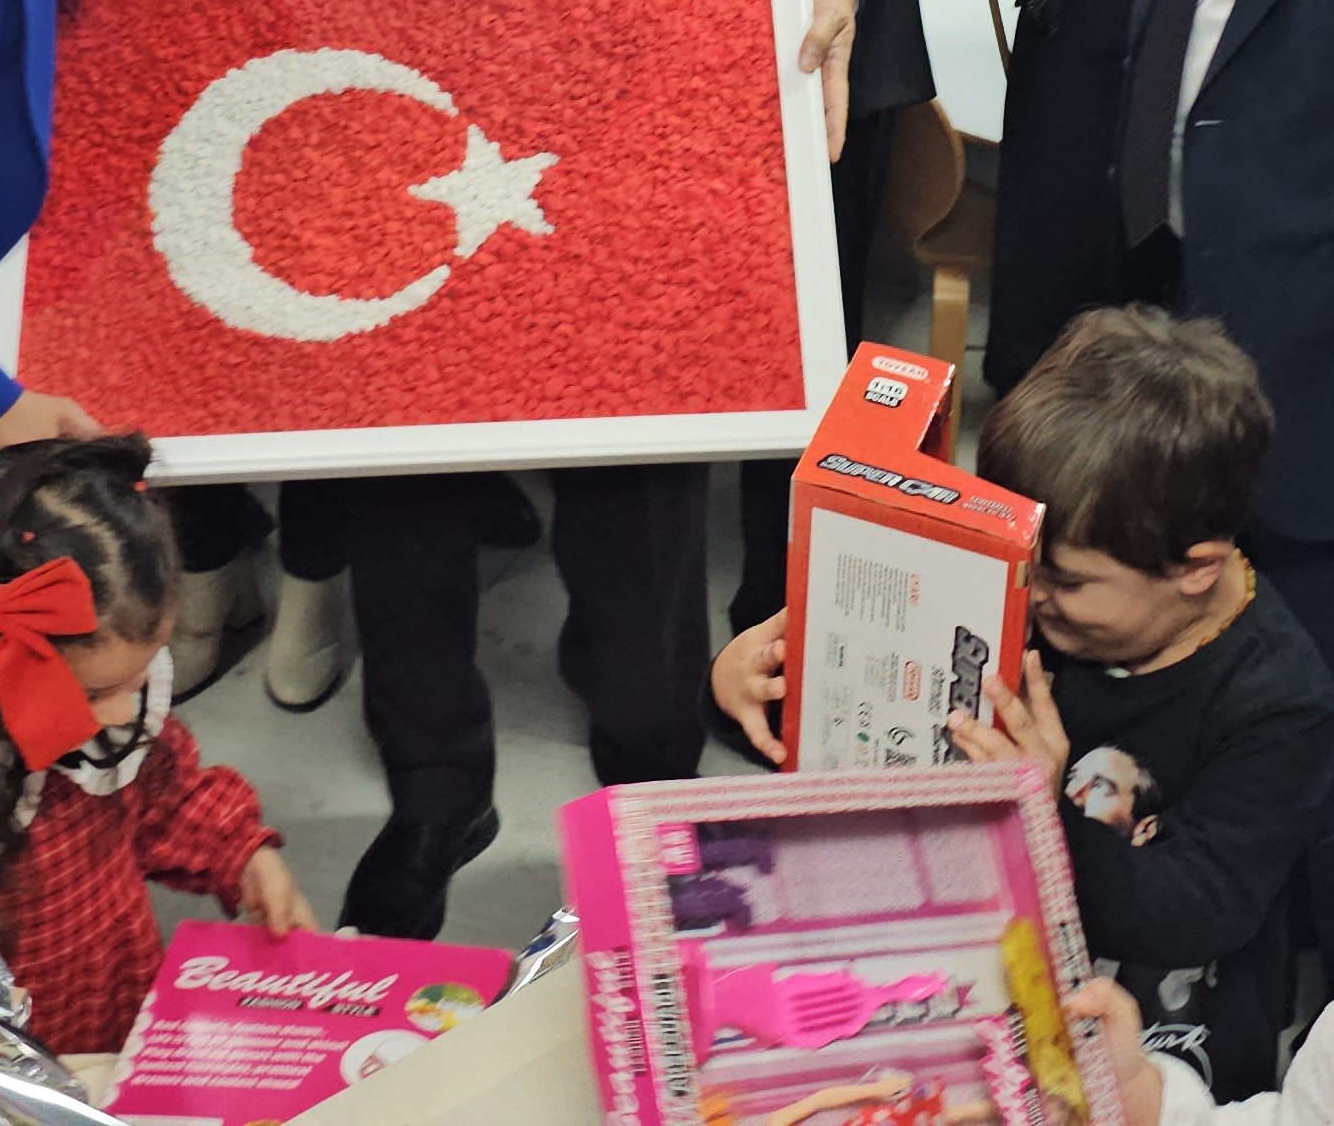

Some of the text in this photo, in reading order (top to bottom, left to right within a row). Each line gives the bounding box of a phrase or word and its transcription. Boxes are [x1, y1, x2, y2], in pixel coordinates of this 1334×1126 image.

[819, 455, 903, 487] SUPER
[898, 478, 960, 504] CAR
[173, 956, 399, 1009] Beautiful
